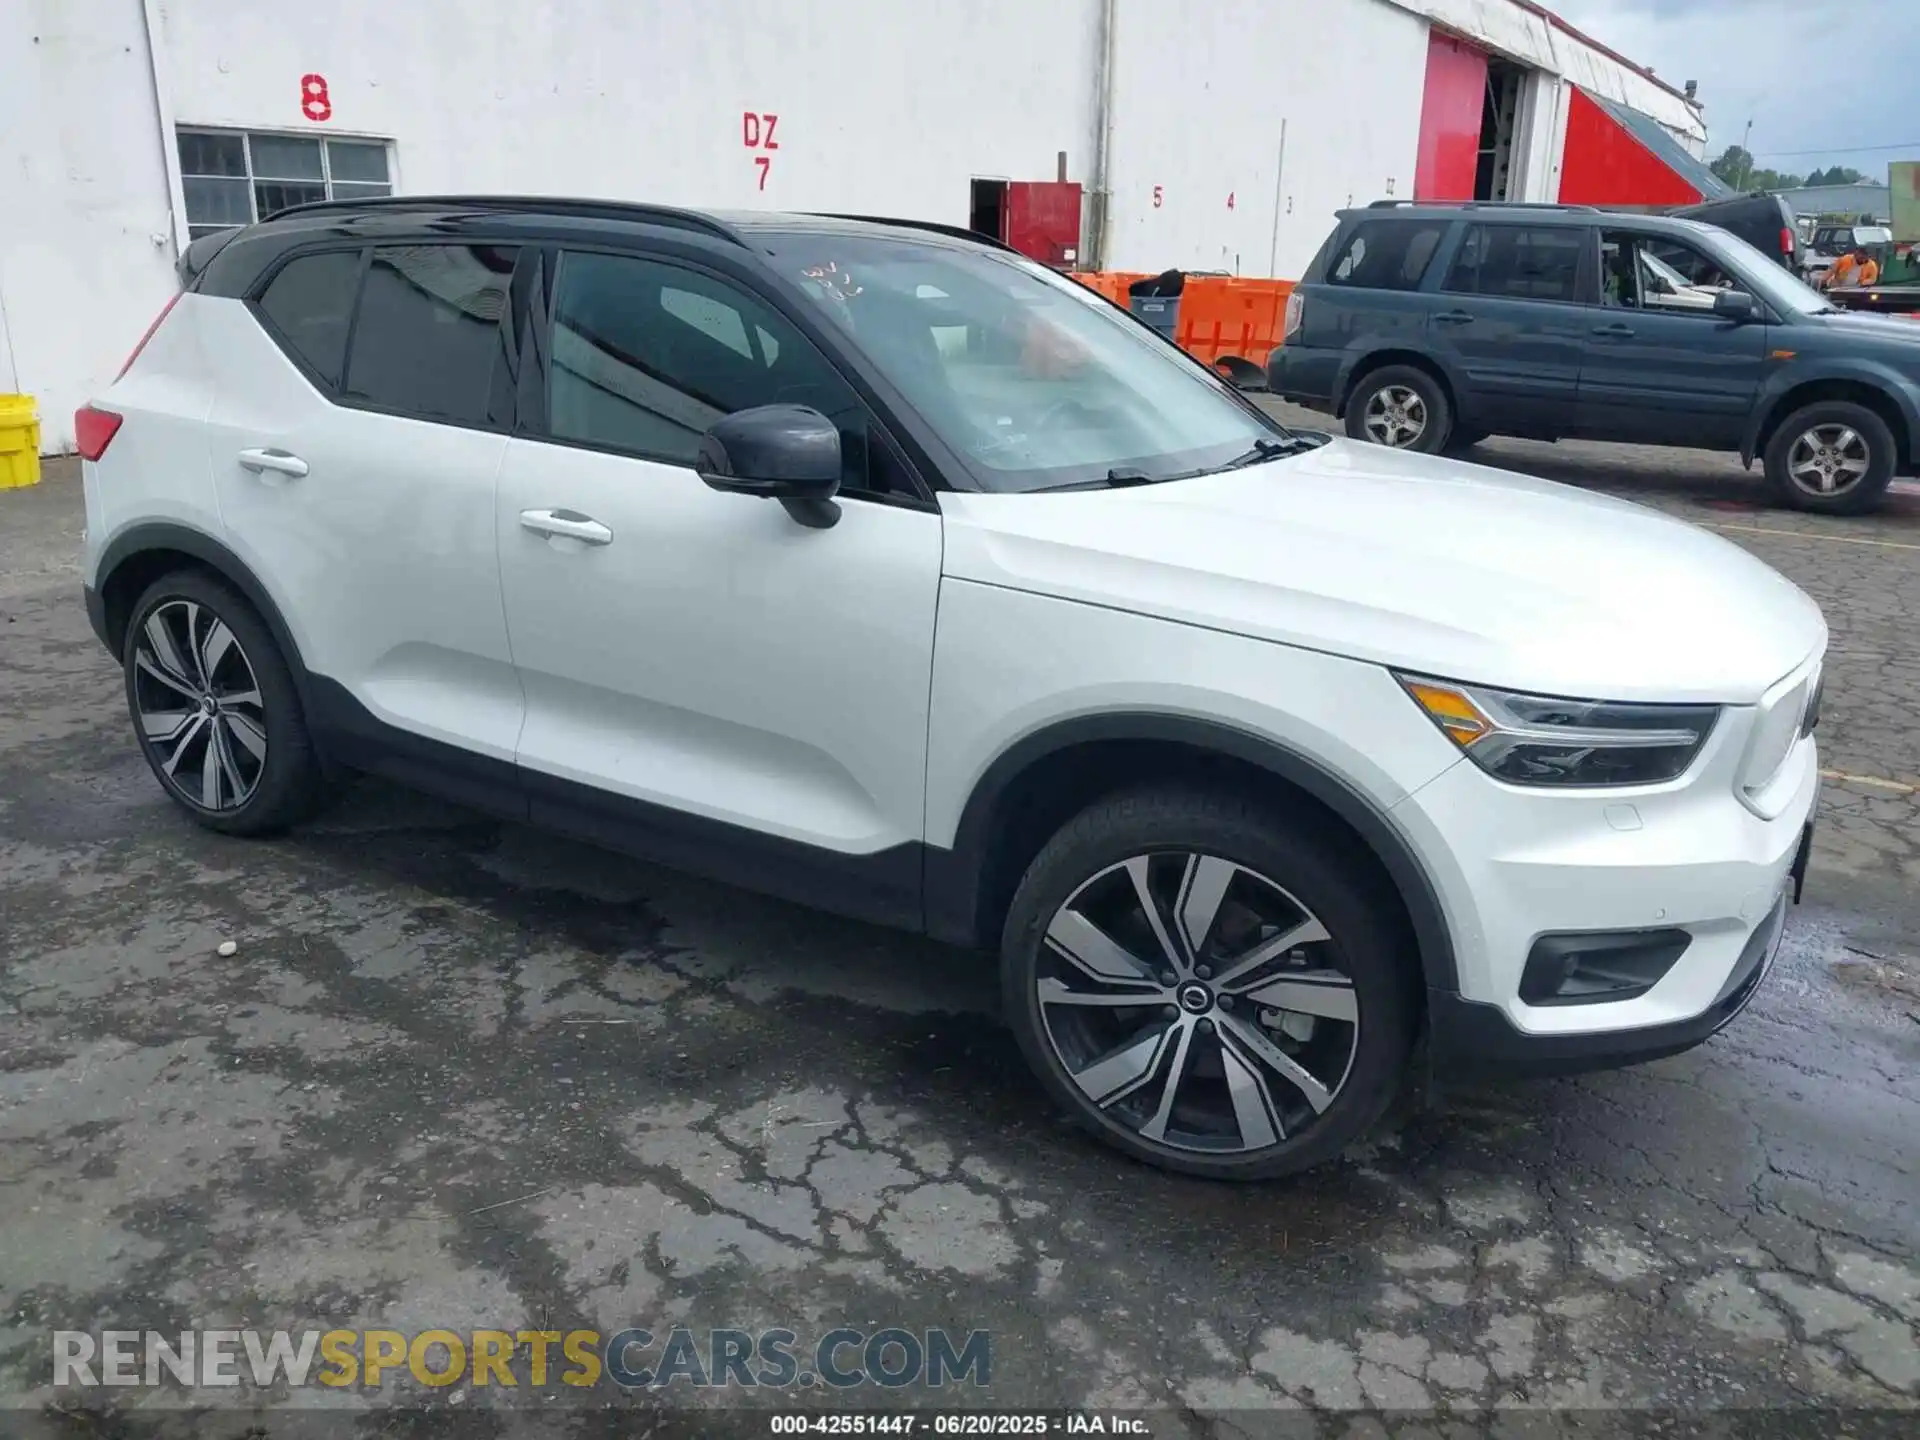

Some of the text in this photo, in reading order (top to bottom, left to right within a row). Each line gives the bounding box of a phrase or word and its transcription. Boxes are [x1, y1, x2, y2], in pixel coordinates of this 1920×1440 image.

[301, 74, 331, 121] 8
[743, 112, 779, 149] DZ
[754, 157, 770, 192] 7
[1153, 185, 1163, 209] 5
[1226, 191, 1235, 212] 4
